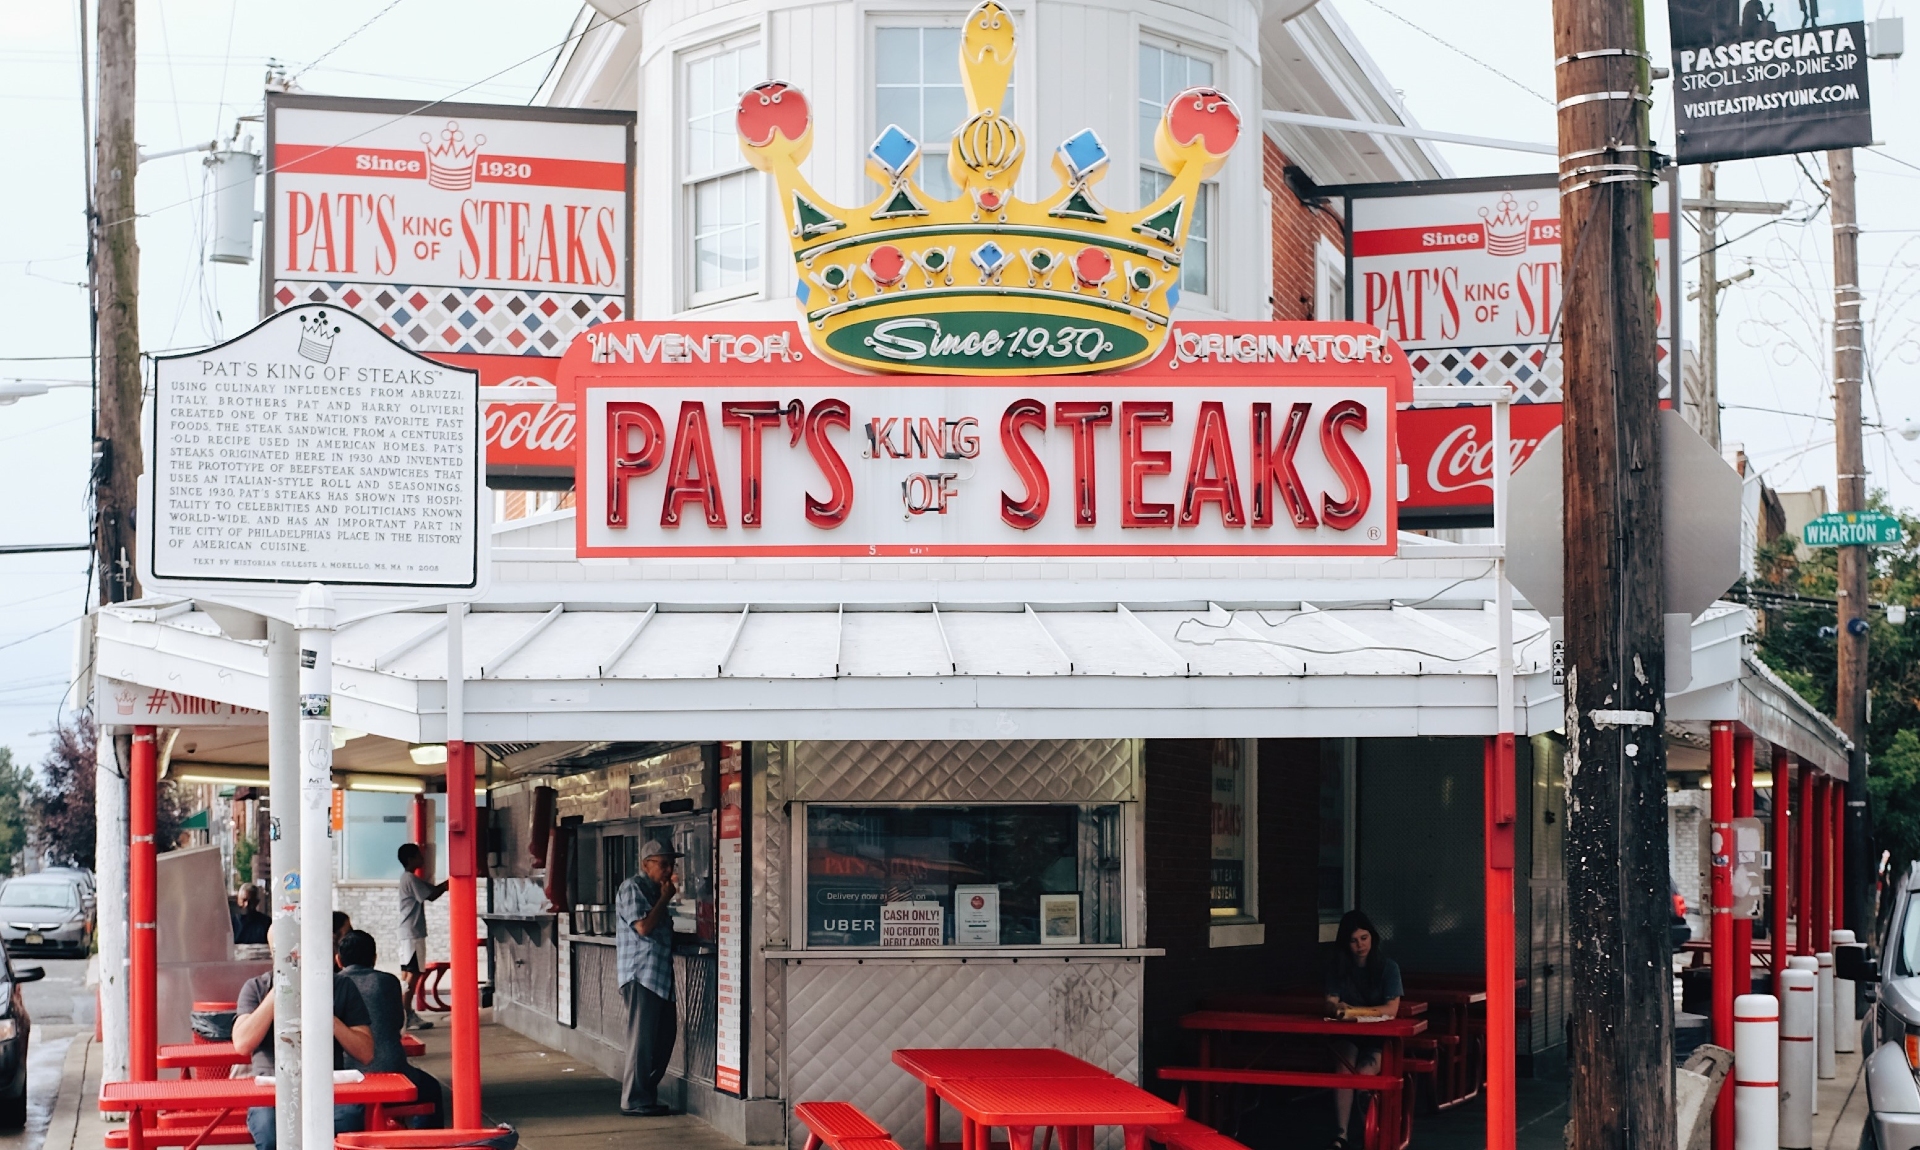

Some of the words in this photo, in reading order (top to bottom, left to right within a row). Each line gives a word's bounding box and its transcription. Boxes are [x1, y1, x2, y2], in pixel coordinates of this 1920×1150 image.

[1680, 28, 1856, 73] PASSEGGIATA
[1684, 84, 1859, 119] VISITEASTPASSYUNK.COM
[356, 154, 421, 173] Since
[480, 161, 532, 178] 1930
[286, 191, 397, 276] PAT'S
[403, 216, 453, 237] KING
[459, 199, 617, 288] STEAKS
[1422, 231, 1479, 246] Since
[414, 241, 441, 261] OF
[1465, 282, 1510, 302] KING
[1363, 267, 1460, 342] PAT'S
[1475, 305, 1500, 323] OF
[592, 332, 792, 364] INVENTOR
[872, 318, 1003, 360] Since
[1004, 326, 1106, 361] 1930
[1176, 333, 1384, 364] ORIGINATOR
[267, 363, 315, 380] KING
[324, 366, 350, 382] OF
[171, 380, 207, 392] USING
[215, 382, 276, 394] CULINARY
[284, 384, 361, 397] INFLUENCES
[370, 387, 405, 398] FROM
[218, 396, 287, 408] BROTHERS
[297, 399, 320, 409] PAT
[327, 401, 351, 410] AND
[361, 402, 401, 412] HARRY
[410, 404, 464, 414] OLIVIERI
[171, 407, 224, 420] CREATED
[231, 409, 255, 421] ONE
[263, 411, 278, 422] OF
[284, 411, 308, 423] THE
[374, 415, 429, 427] FAVORITE
[436, 417, 464, 428] FAST
[216, 422, 239, 433] THE
[245, 423, 283, 434] STEAK
[353, 427, 385, 439] FROM
[389, 430, 397, 439] A
[401, 429, 463, 441] CENTURIES
[870, 416, 981, 460] KING
[208, 435, 251, 446] RECIPE
[259, 436, 290, 448] USED
[297, 438, 309, 448] IN
[316, 438, 376, 451] AMERICAN
[434, 443, 463, 454] PAT'S
[169, 446, 214, 459] STEAKS
[219, 448, 289, 461] ORIGINATED
[295, 451, 326, 463] HERE
[332, 452, 343, 462] IN
[349, 453, 373, 464] 1930
[378, 454, 400, 465] AND
[406, 454, 463, 467] INVENTED
[607, 398, 855, 530] PAT'S
[1000, 398, 1372, 530] STEAKS
[169, 459, 193, 470] THE
[198, 460, 264, 474] PROTOTYPE
[270, 463, 285, 473] OF
[289, 463, 356, 477] BEEFSTEAK
[360, 466, 431, 479] SANDWICHES
[434, 469, 463, 480] THAT
[169, 472, 198, 483] USES
[203, 474, 218, 485] AN
[223, 474, 314, 488] ITALIAN-STYLE
[321, 477, 351, 489] ROLL
[357, 479, 379, 490] AND
[169, 485, 202, 497] SINCE
[238, 488, 269, 500] PAT'S
[275, 489, 321, 501] STEAKS
[327, 491, 348, 502] HAS
[355, 492, 396, 504] SHOWN
[402, 493, 420, 505] ITS
[903, 472, 959, 515] OF
[169, 498, 210, 511] TALITY
[213, 500, 232, 510] TO
[237, 501, 310, 514] CELEBRITIES
[315, 503, 338, 515] AND
[344, 504, 416, 518] POLITICIANS
[422, 507, 462, 518] KNOWN
[256, 514, 280, 525] AND
[287, 515, 308, 527] HAS
[314, 516, 330, 528] AN
[338, 517, 407, 530] IMPORTANT
[414, 520, 444, 531] PART
[450, 522, 462, 532] IN
[1807, 523, 1877, 543] WHARTON
[1885, 528, 1897, 541] ST
[168, 525, 192, 536] THE
[197, 526, 224, 537] CITY
[228, 527, 243, 538] OF
[337, 530, 370, 541] PLACE
[375, 531, 386, 542] IN
[390, 532, 412, 543] THE
[418, 533, 463, 545] HISTORY
[169, 539, 184, 548] OF
[193, 540, 252, 551] AMERICAN
[193, 557, 215, 565] TEXT
[281, 560, 318, 569] CELESTE
[1553, 641, 1564, 684] CHOICE
[826, 892, 860, 902] Delivery
[824, 920, 875, 931] UBER
[883, 910, 909, 921] CASH
[912, 910, 940, 921] ONLY!
[883, 927, 895, 936] NO
[897, 927, 926, 936] CREDIT
[928, 927, 940, 936] OR
[883, 938, 907, 946] DEBIT
[909, 938, 940, 946] CARDS!
